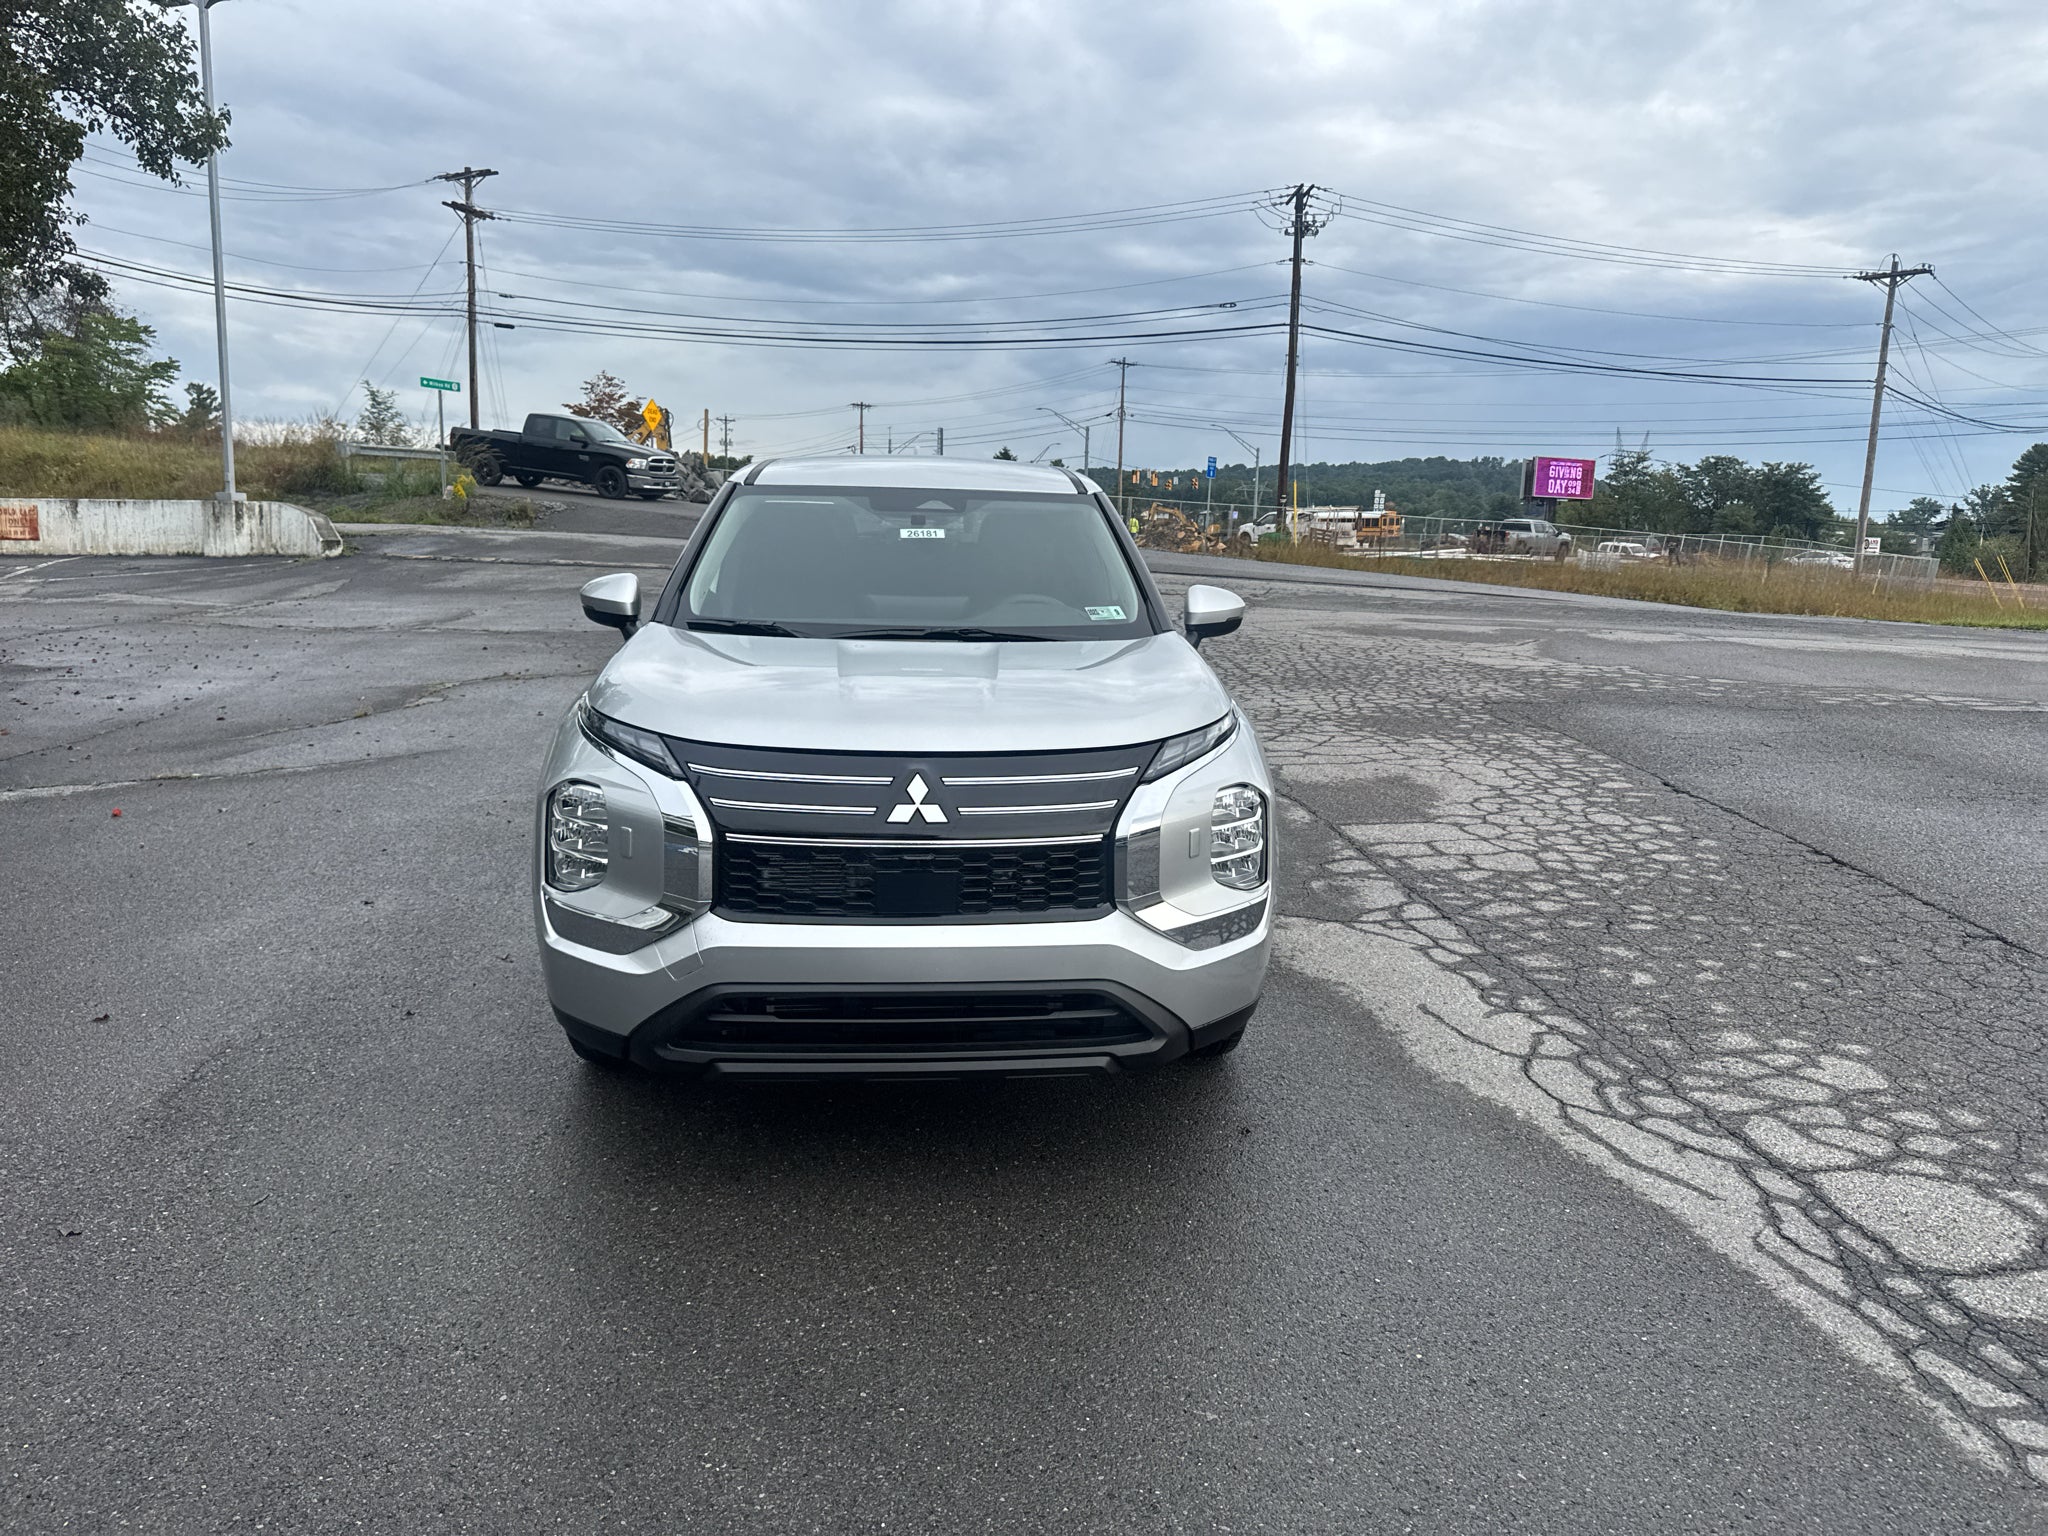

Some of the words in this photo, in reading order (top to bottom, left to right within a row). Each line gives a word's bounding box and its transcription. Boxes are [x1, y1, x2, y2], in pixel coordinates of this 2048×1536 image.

[1549, 465, 1583, 480] GIVING
[1547, 479, 1568, 494] DAY
[906, 529, 938, 538] 26181
